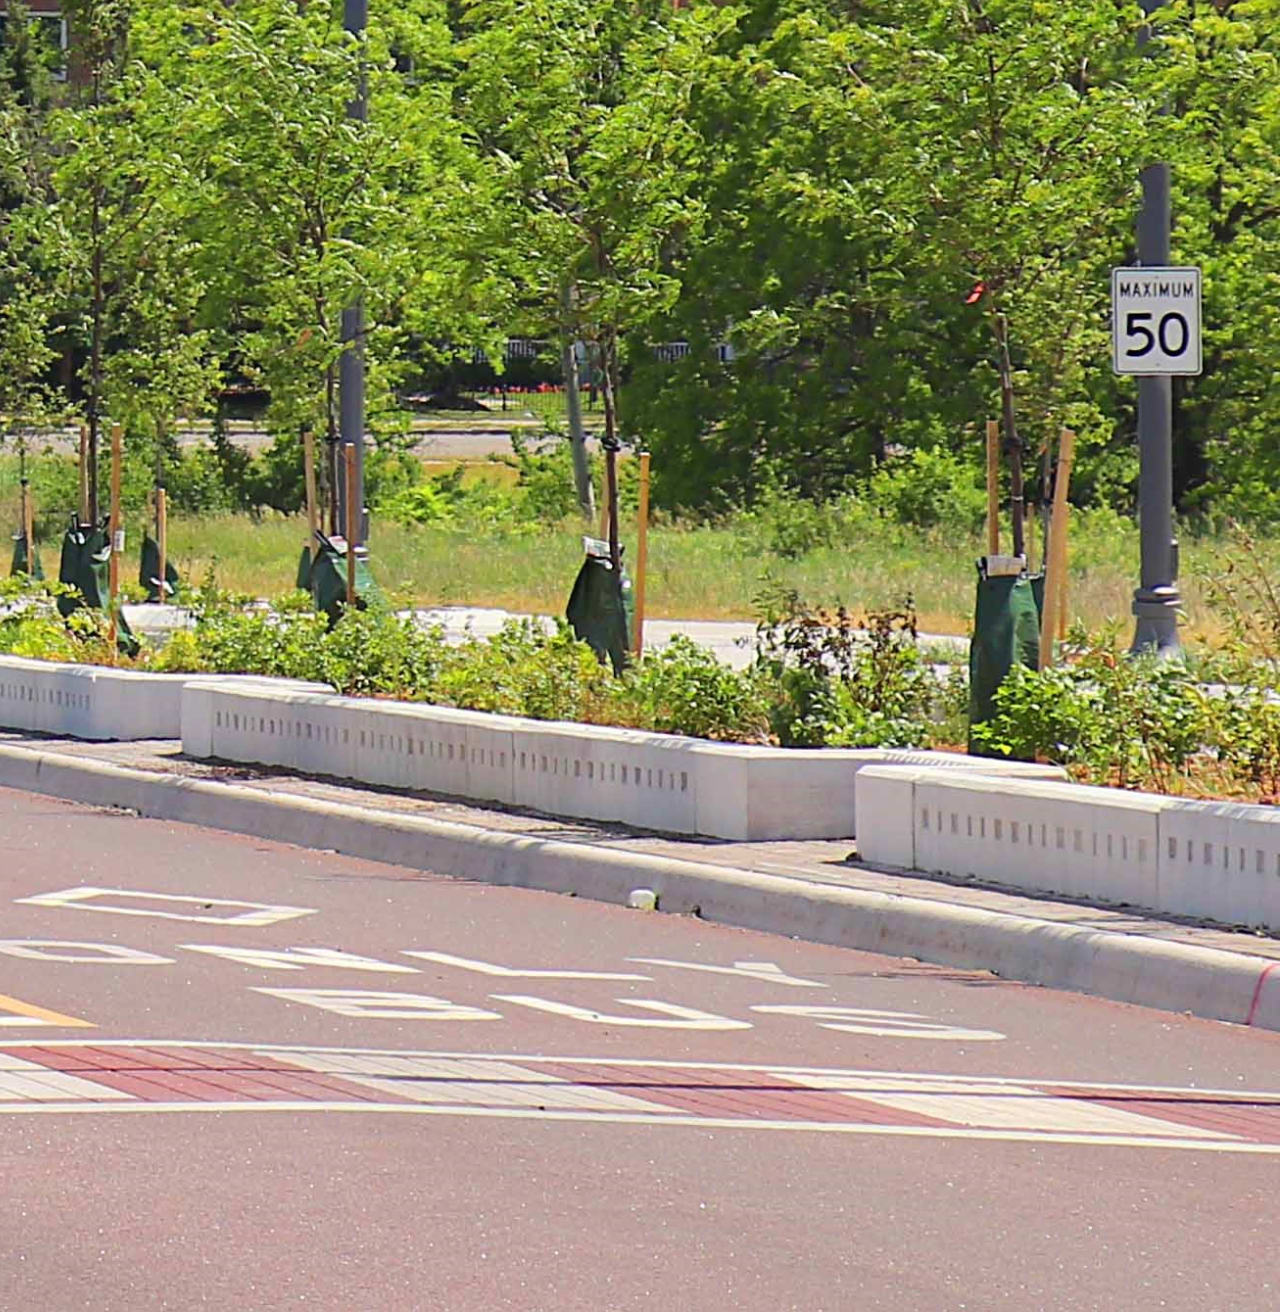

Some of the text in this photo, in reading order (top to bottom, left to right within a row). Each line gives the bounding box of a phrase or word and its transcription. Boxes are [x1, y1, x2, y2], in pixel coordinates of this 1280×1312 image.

[1119, 281, 1195, 298] MAXIMUM
[1124, 311, 1190, 358] 50
[248, 986, 1007, 1041] BUS
